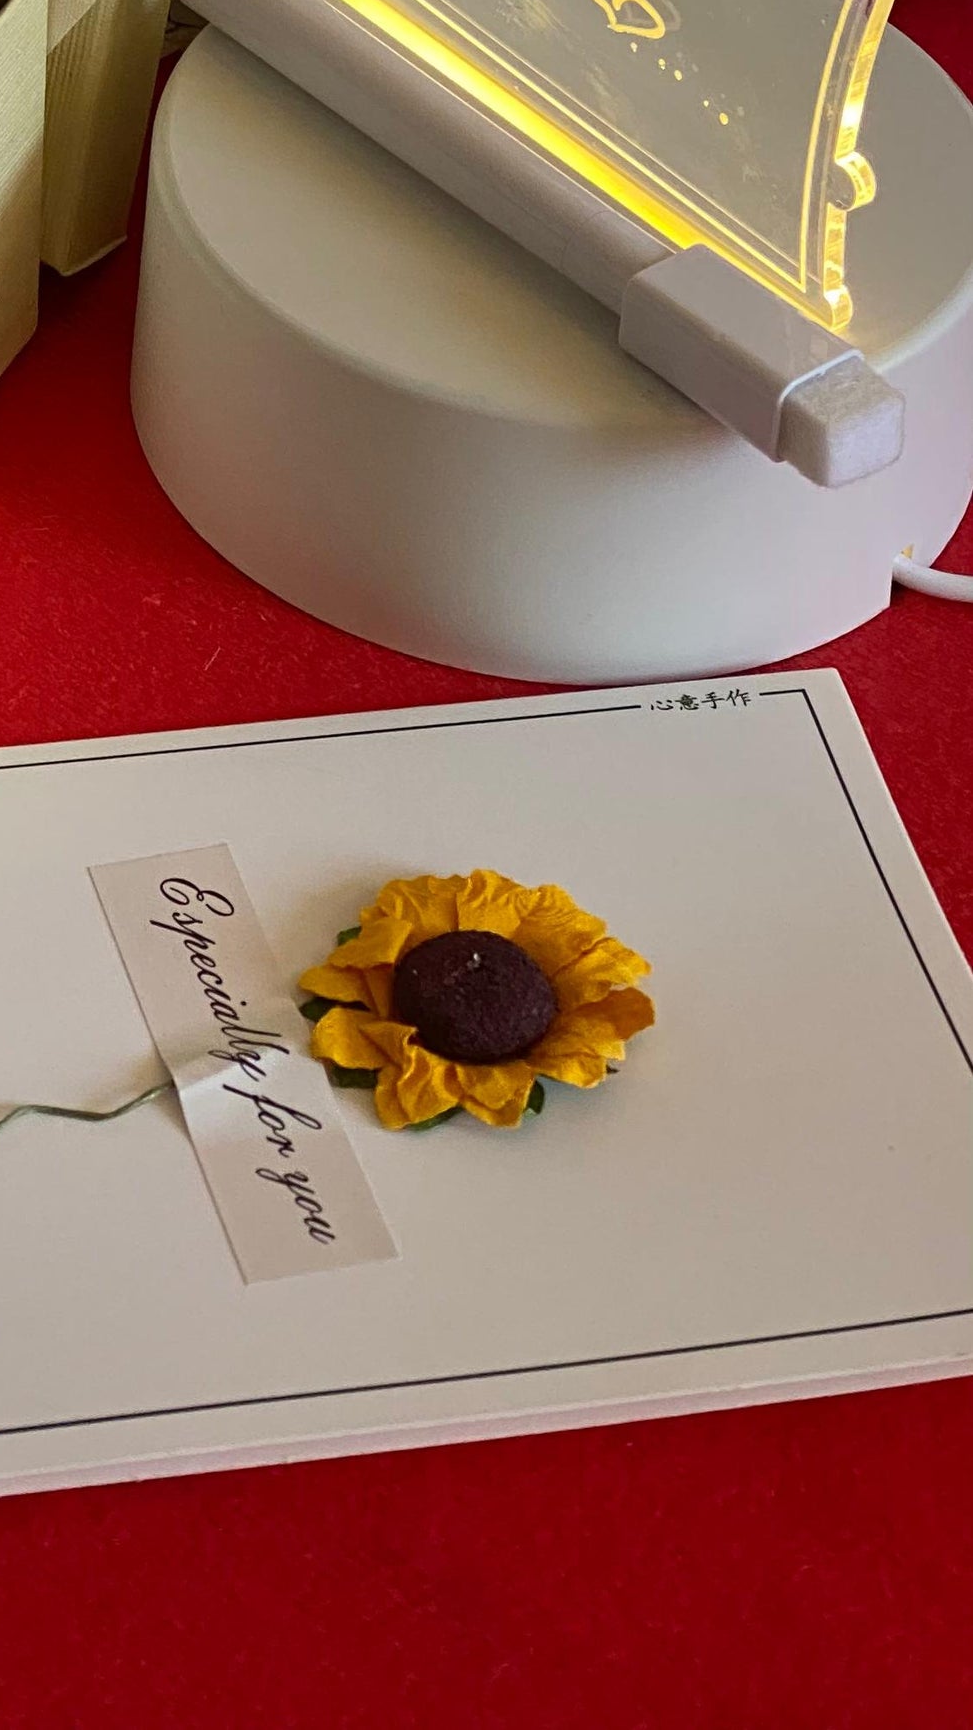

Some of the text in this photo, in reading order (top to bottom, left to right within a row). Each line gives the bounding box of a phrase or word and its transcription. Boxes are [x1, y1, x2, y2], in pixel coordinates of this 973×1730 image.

[650, 689, 751, 711] 心意手作
[149, 876, 336, 1246] Especially for you
